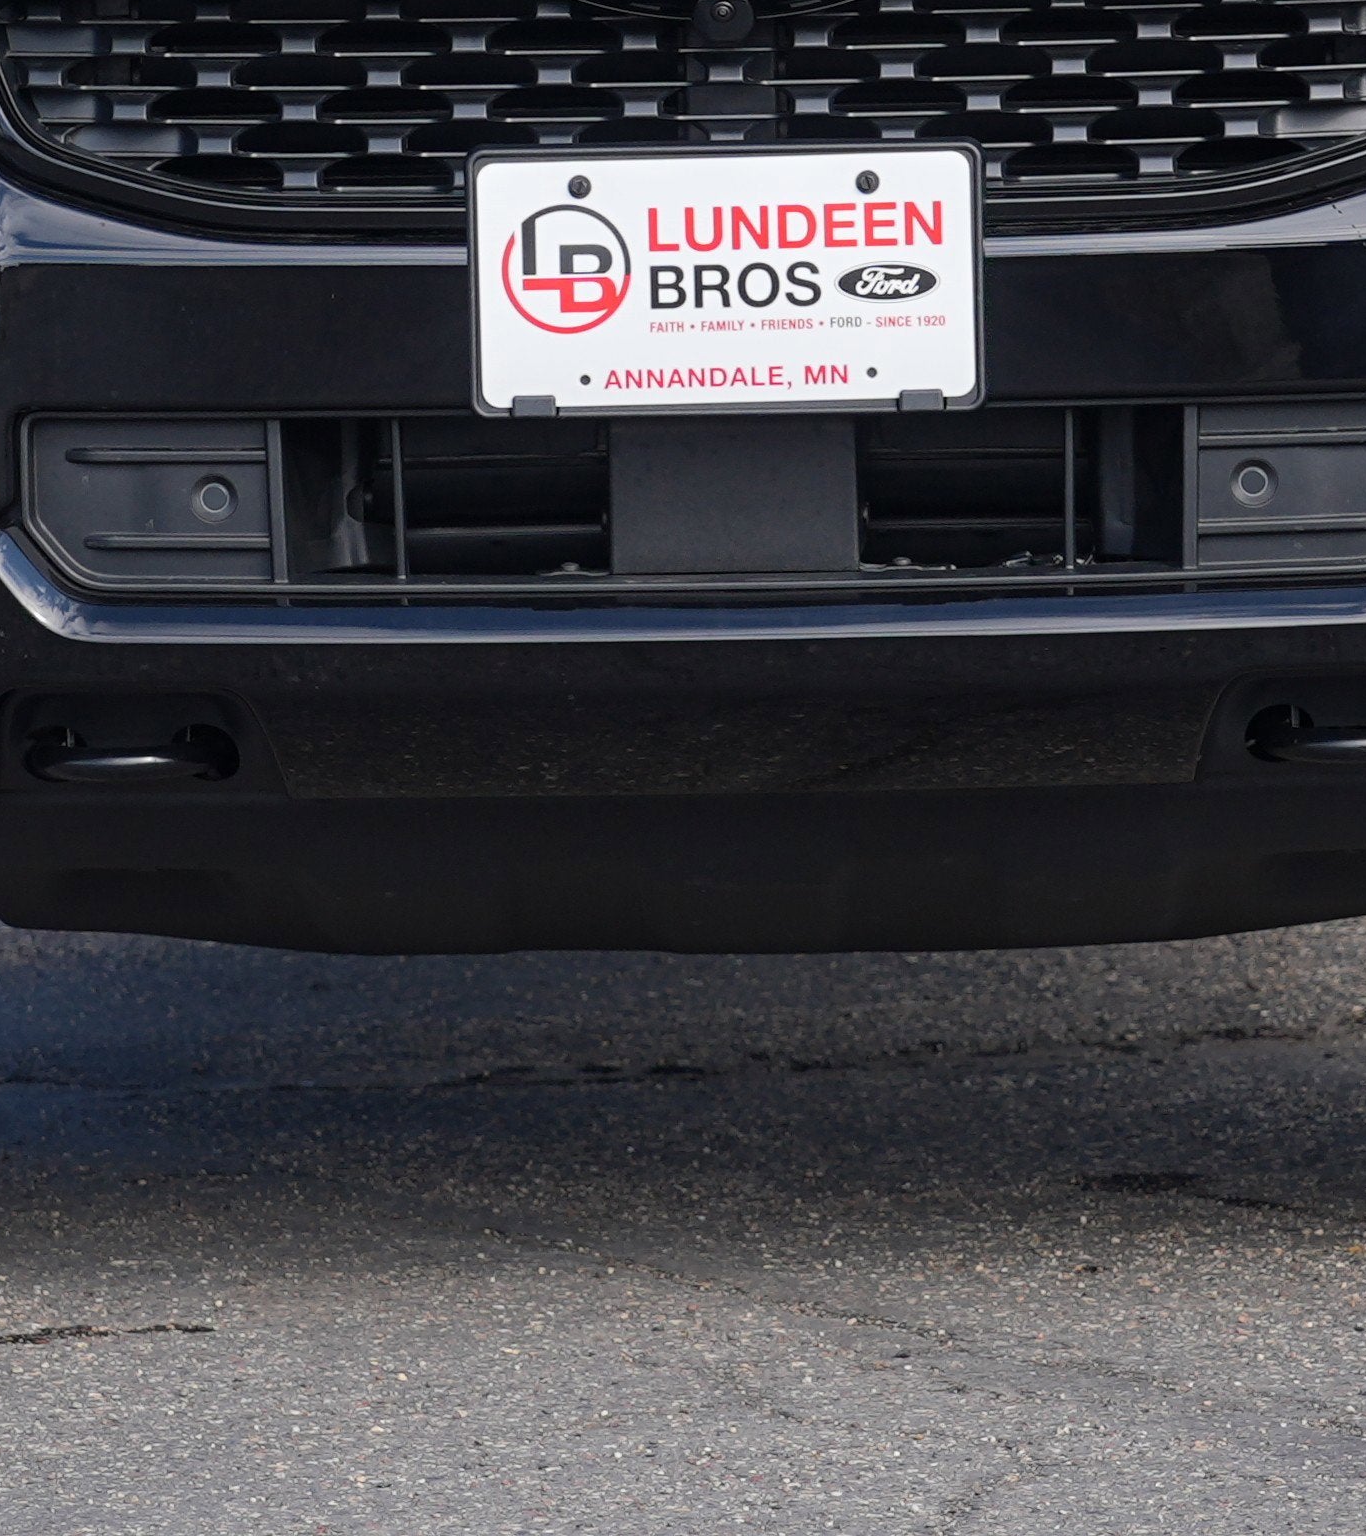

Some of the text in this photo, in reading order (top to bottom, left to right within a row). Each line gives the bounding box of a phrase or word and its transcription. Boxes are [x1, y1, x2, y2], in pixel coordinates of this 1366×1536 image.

[647, 200, 943, 253] LUNDEEN
[649, 261, 822, 309] BROS
[855, 266, 921, 296] Ford
[649, 314, 946, 333] FAITH FAMILY FRIENDS FORD SINCE 1920
[603, 364, 849, 390] ANNANDALE, MN
